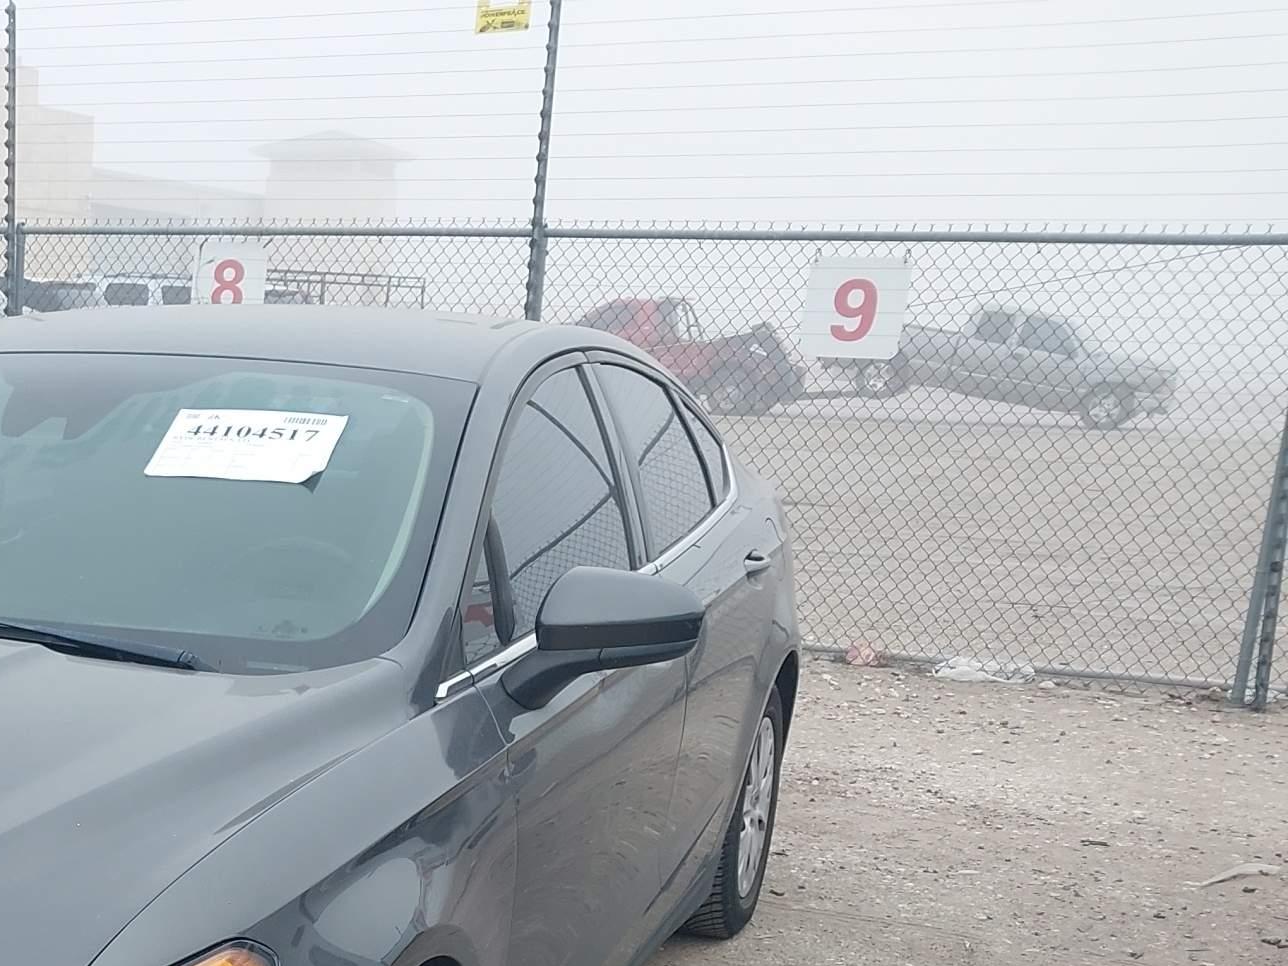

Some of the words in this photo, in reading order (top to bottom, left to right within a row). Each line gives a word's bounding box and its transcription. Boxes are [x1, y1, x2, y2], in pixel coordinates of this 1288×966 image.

[211, 259, 245, 305] 8
[830, 278, 878, 342] 9
[187, 424, 321, 442] 44104517
